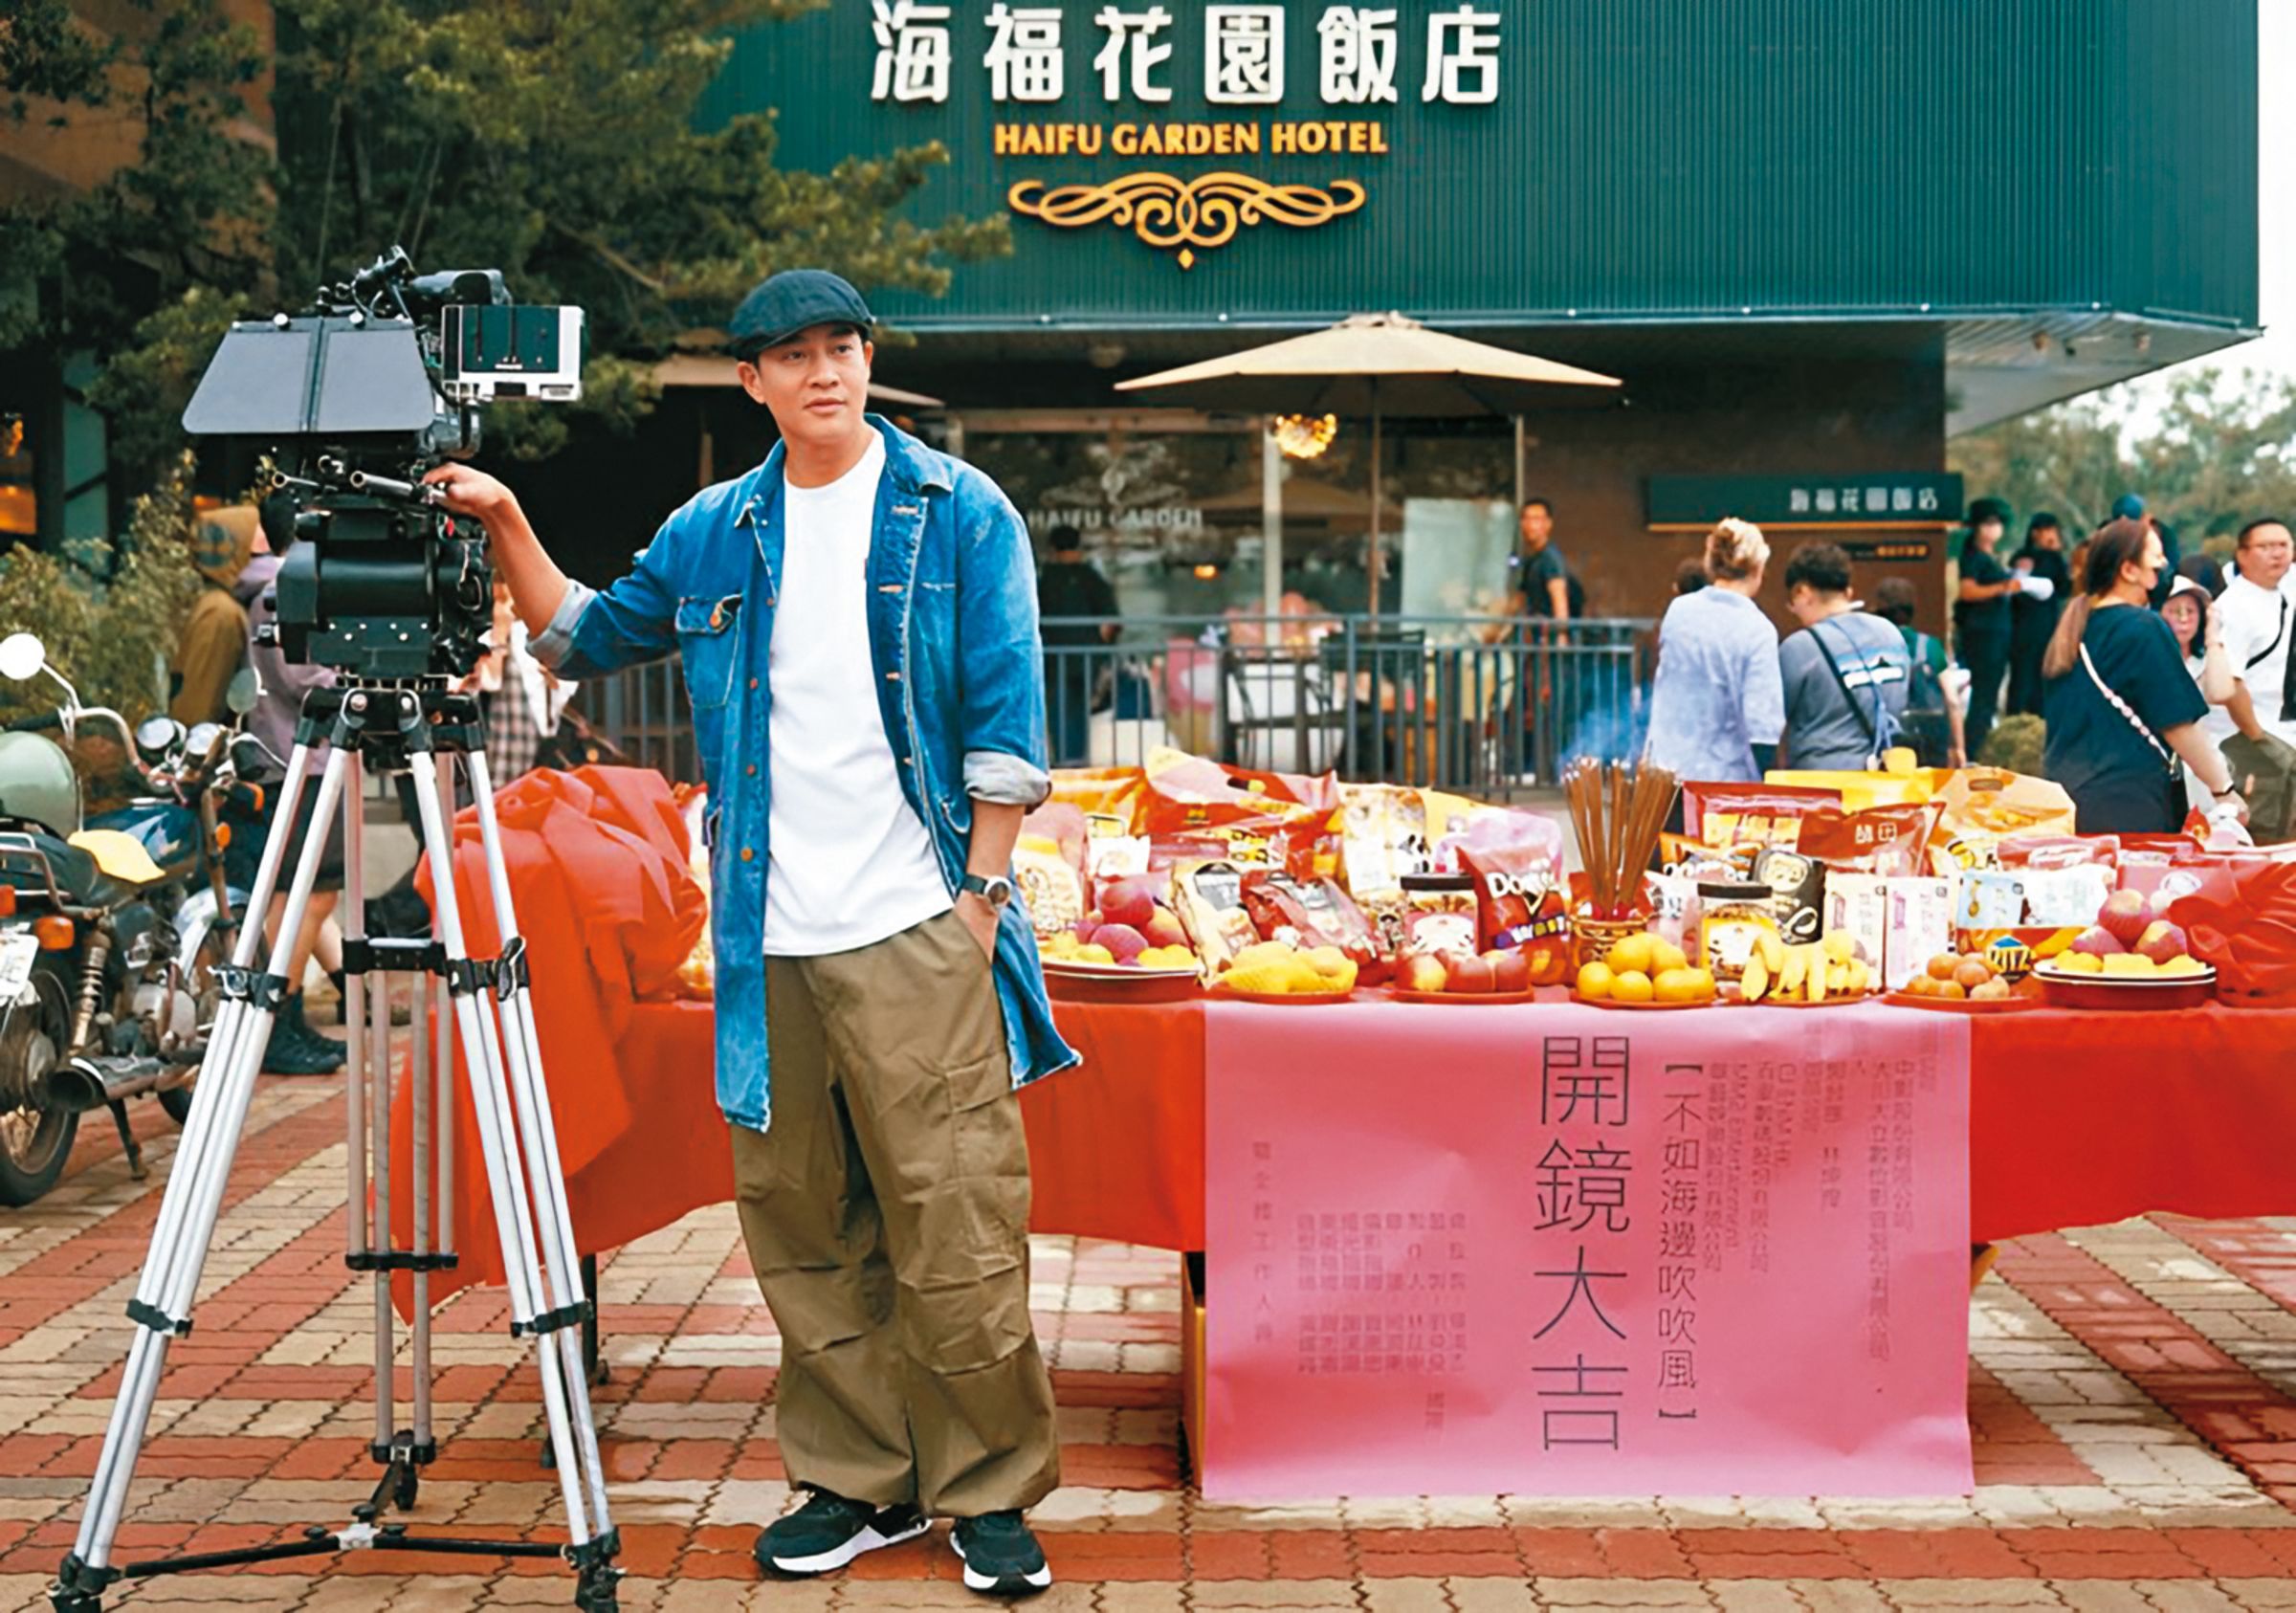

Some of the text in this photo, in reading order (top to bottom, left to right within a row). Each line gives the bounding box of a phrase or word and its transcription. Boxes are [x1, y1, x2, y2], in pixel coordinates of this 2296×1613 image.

[871, 1, 1500, 103] 海福花園飯店
[994, 122, 1388, 155] HAIFU GARDEN HOTEL
[1532, 1036, 1632, 1450] 開鏡大吉
